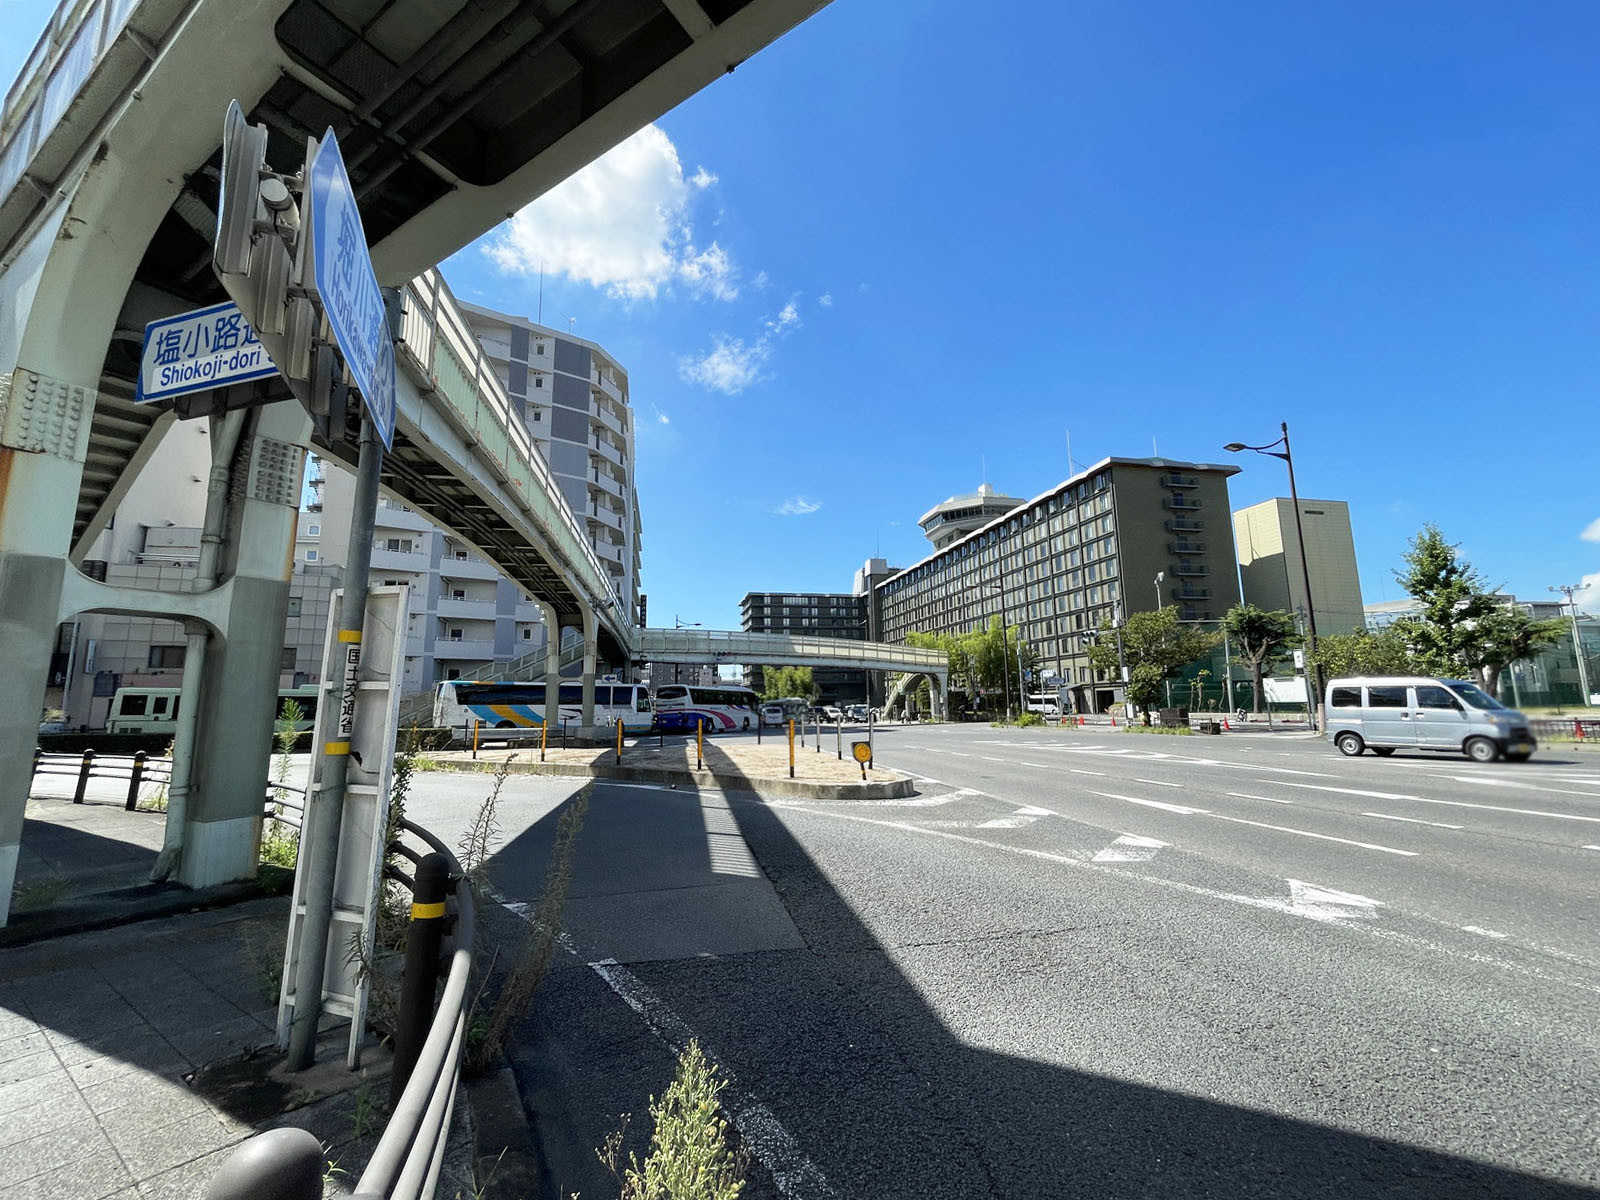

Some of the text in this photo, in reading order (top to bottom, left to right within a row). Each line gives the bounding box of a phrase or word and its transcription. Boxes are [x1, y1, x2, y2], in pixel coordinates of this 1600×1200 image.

[160, 346, 262, 387] Shiokoji-dori
[340, 648, 361, 734] 国土交通省
